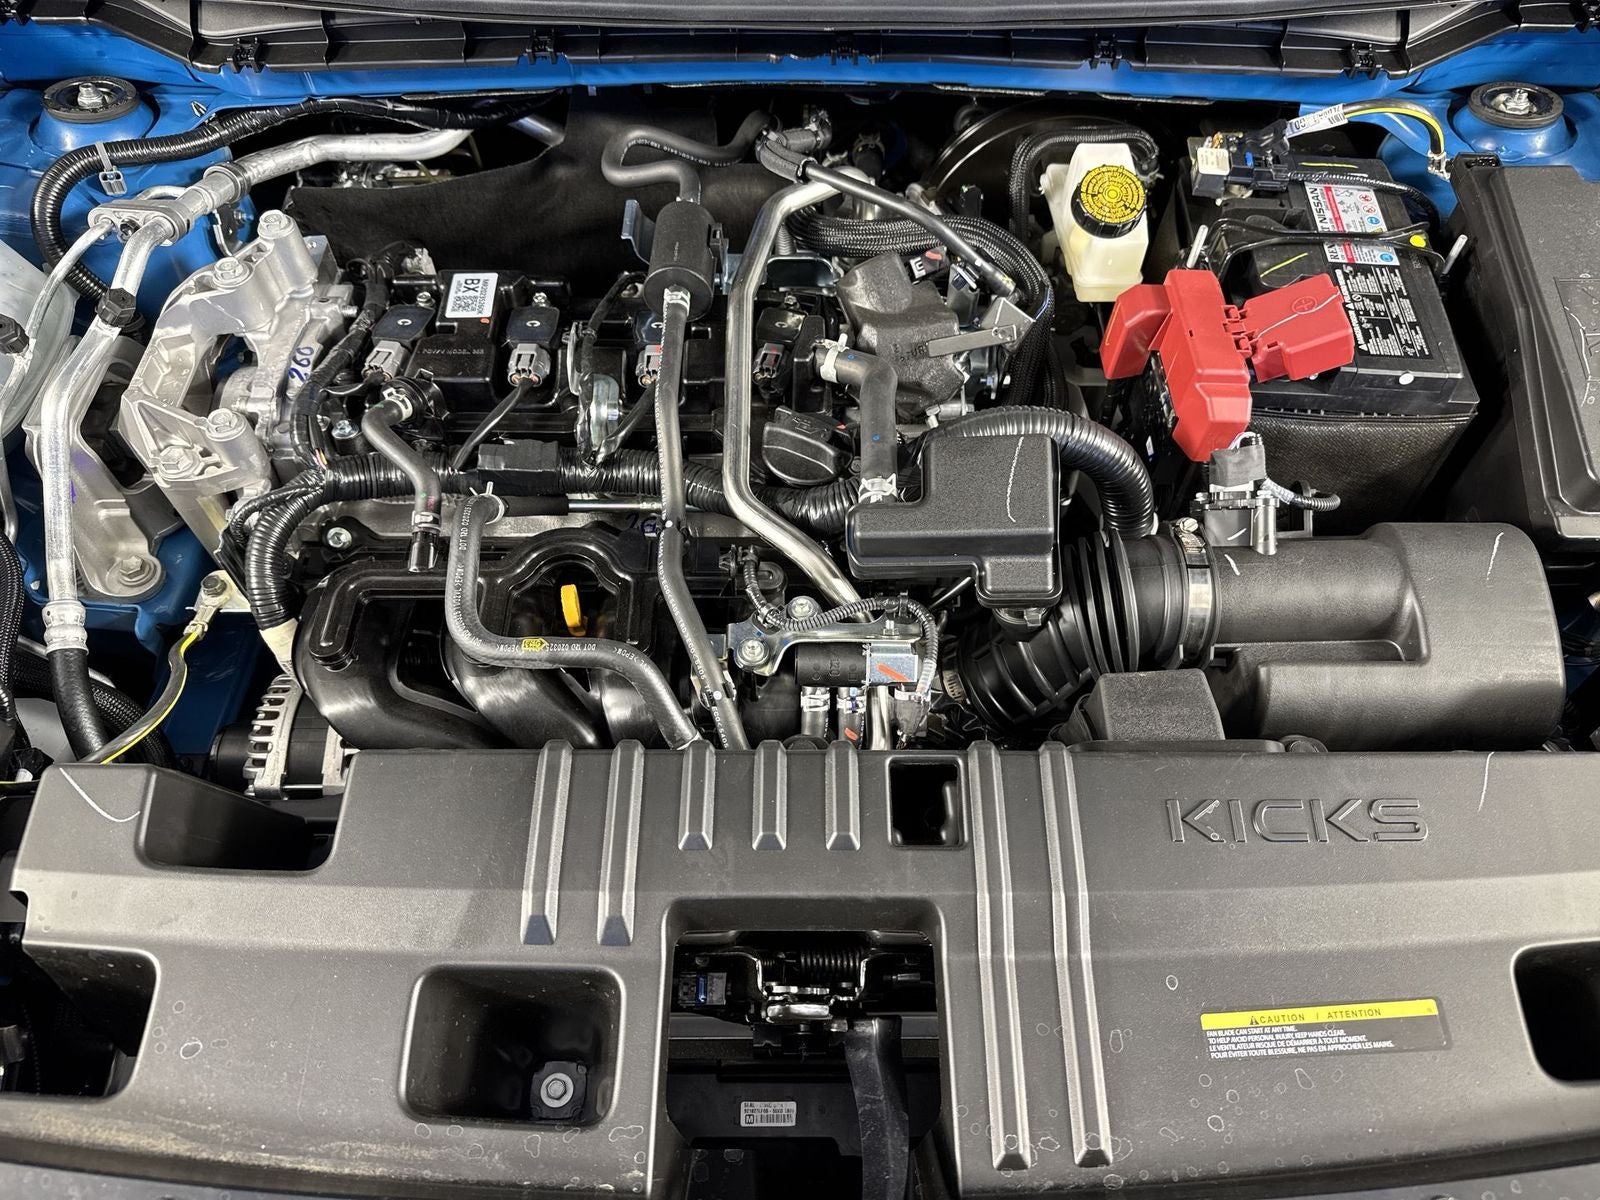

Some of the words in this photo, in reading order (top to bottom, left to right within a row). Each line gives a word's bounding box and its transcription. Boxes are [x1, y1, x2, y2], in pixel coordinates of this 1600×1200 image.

[1309, 187, 1328, 224] NISSAN
[462, 278, 480, 293] BX
[1167, 799, 1428, 842] KICKS
[1260, 1013, 1304, 1024] CAUTION
[1327, 1008, 1381, 1019] ATTENTION
[1217, 1043, 1255, 1051] VENTILATEUR
[1286, 1038, 1317, 1046] DÉMARRER
[1228, 1049, 1248, 1057] ÉVITER
[1328, 1043, 1362, 1051] APPROCHER
